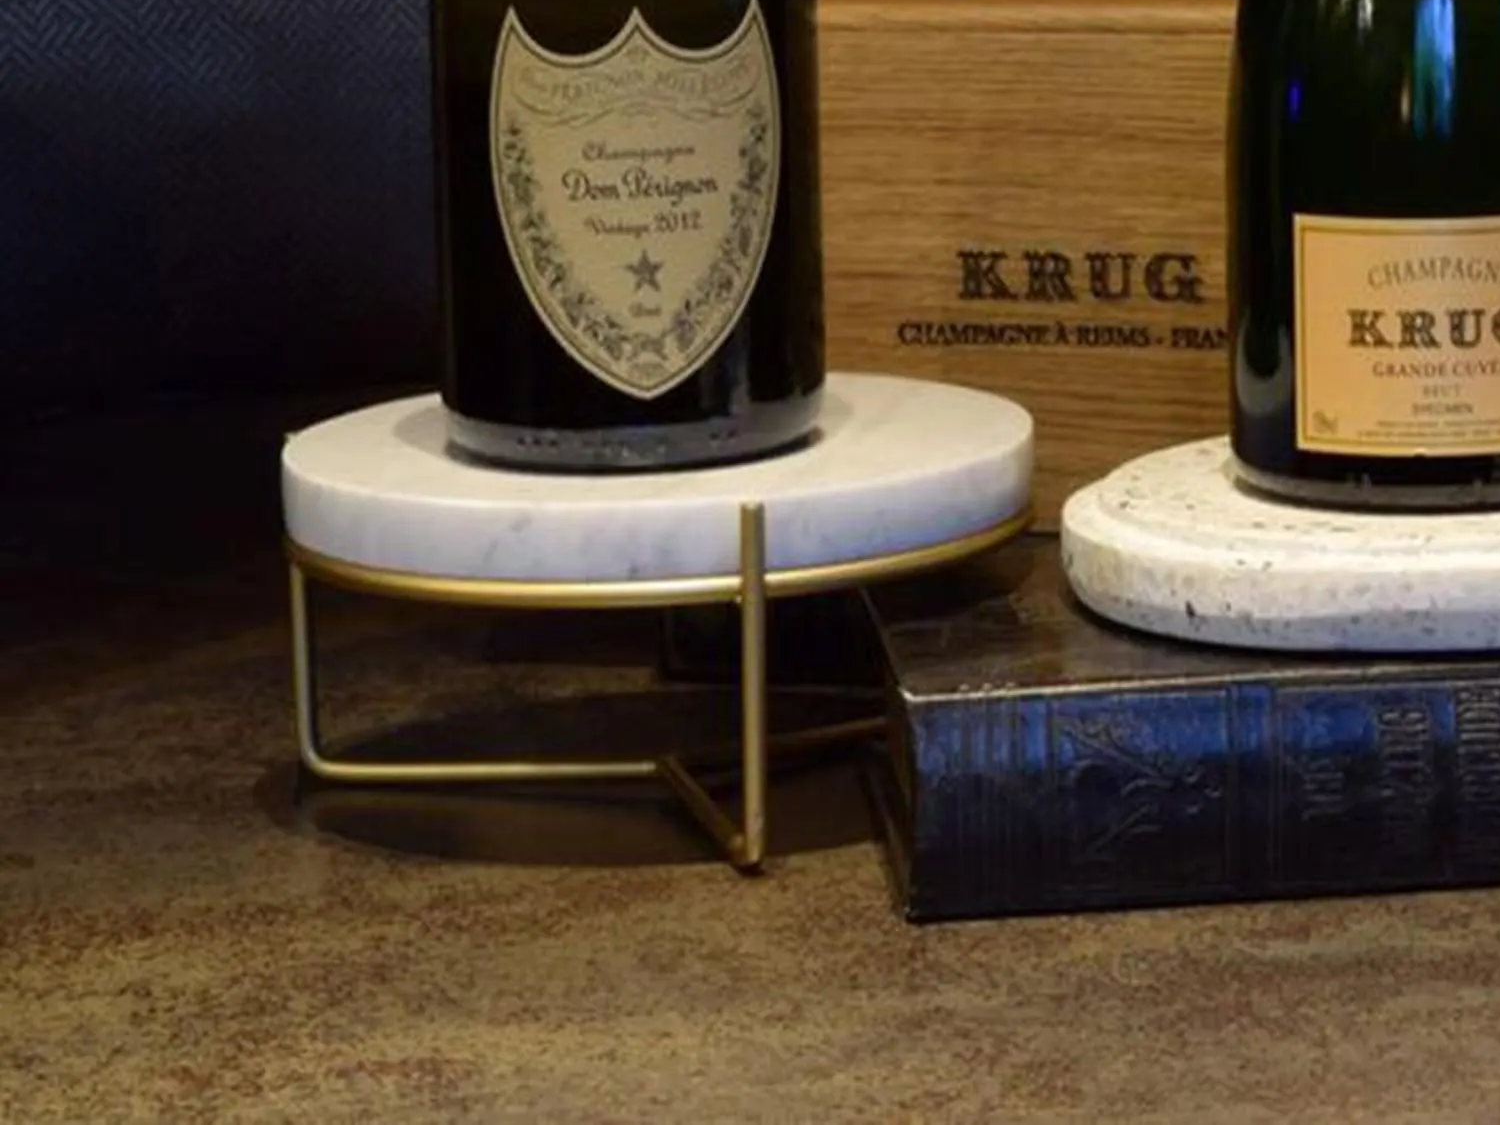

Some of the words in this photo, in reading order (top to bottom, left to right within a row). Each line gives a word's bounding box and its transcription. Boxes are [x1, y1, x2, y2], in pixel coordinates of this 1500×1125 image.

[561, 169, 620, 201] Dom
[621, 167, 718, 207] Pérignon
[653, 209, 703, 233] 2012
[956, 249, 1207, 304] KRUG
[898, 321, 1048, 347] CHAMPAGNE
[1076, 325, 1150, 348] REIMS
[1372, 359, 1446, 380] GRANDE
